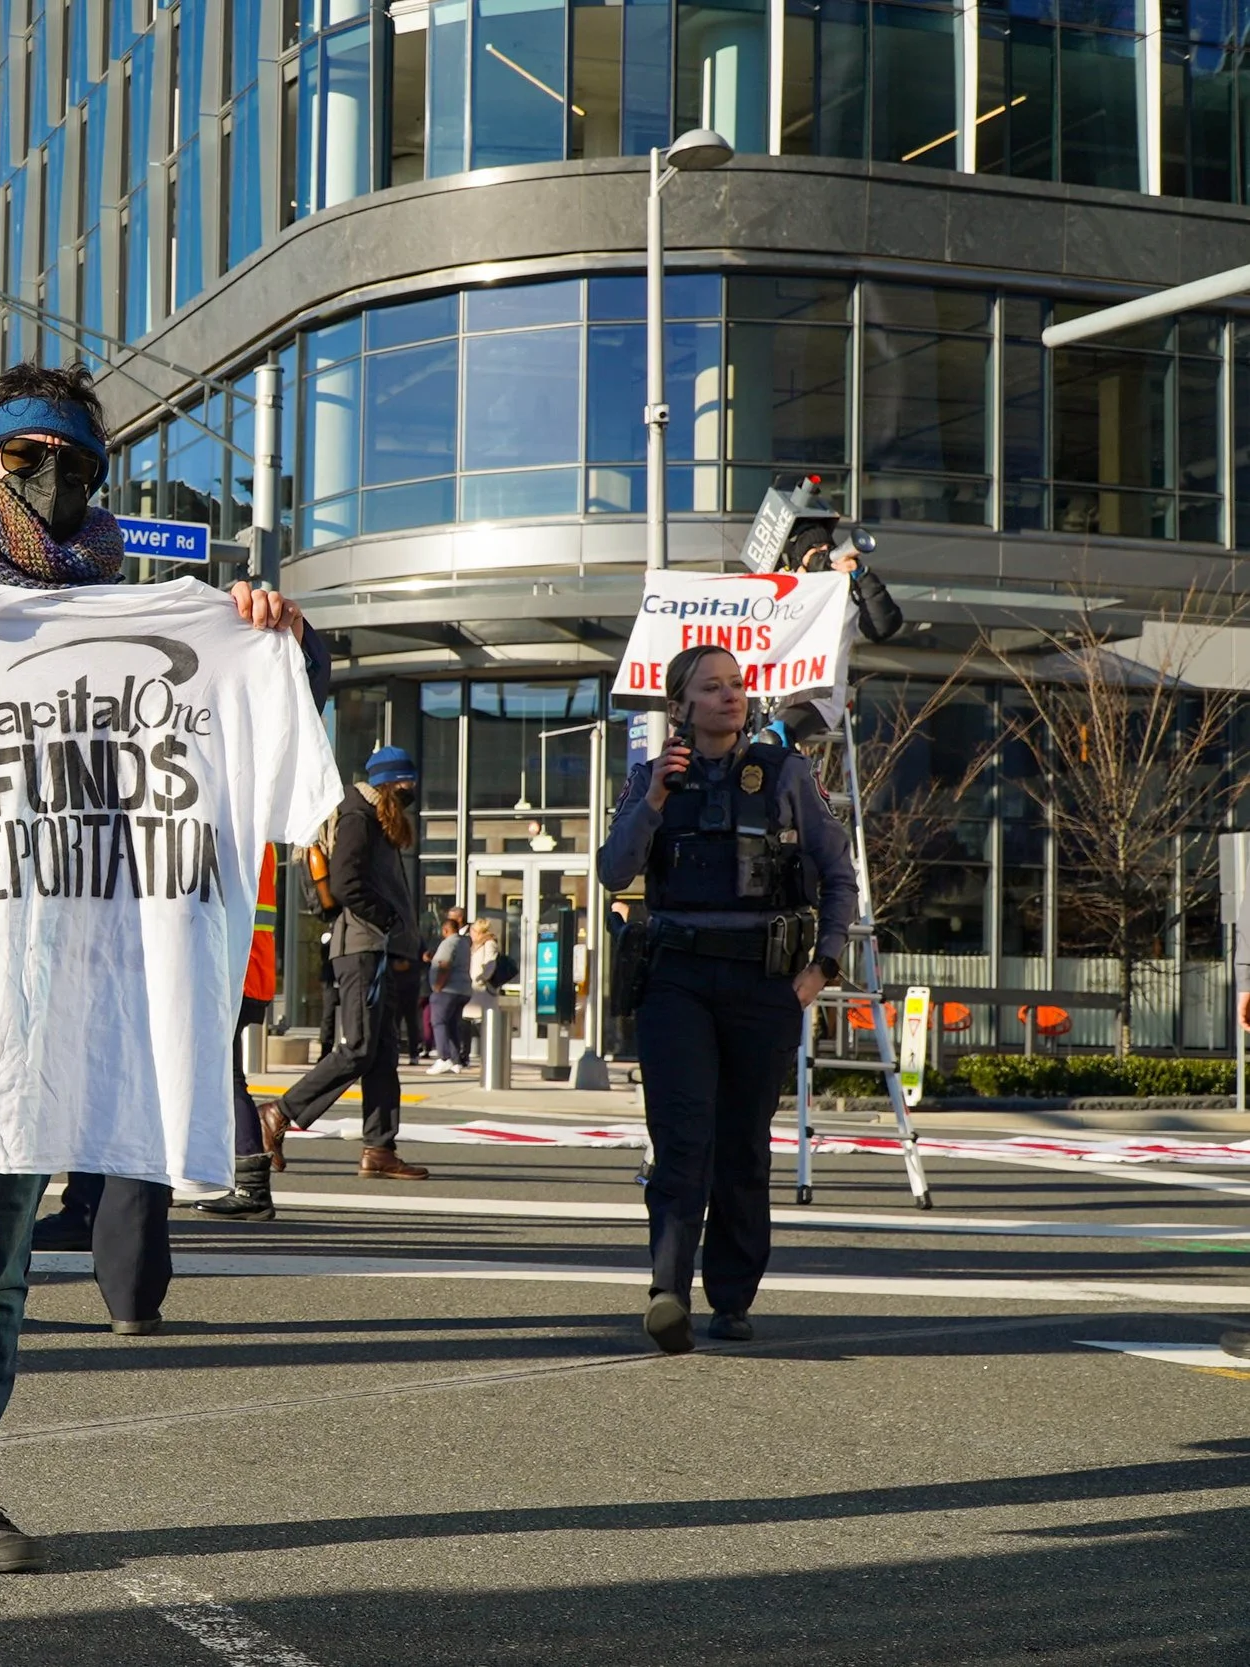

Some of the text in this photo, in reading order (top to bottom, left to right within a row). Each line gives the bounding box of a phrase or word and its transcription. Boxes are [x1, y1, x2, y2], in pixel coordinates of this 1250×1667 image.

[121, 528, 195, 550] ower Rd
[747, 502, 778, 564] ELBIT
[756, 506, 792, 574] VEILLANCE
[681, 624, 772, 651] FUNDS
[629, 654, 827, 692] DEATION
